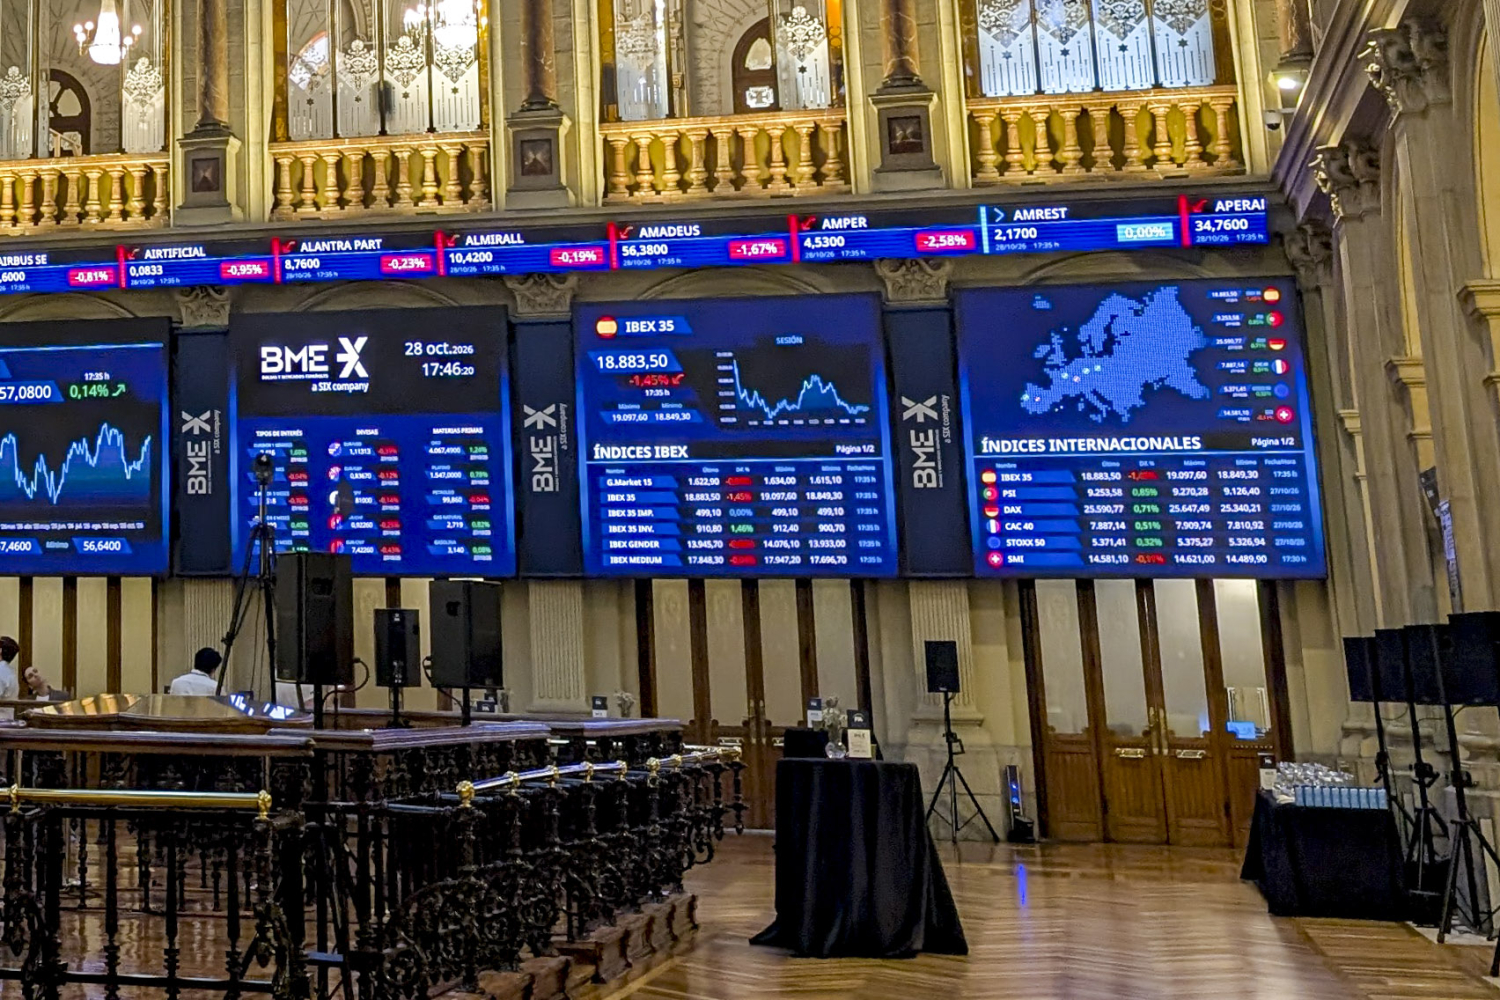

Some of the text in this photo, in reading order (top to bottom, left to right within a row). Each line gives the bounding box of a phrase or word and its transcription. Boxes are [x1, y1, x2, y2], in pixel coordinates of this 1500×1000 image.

[1013, 208, 1068, 222] AMREST
[822, 217, 868, 230] AMPER
[1195, 219, 1248, 231] 34,7600
[639, 225, 700, 239] AMADEUS
[995, 228, 1037, 240] 2,1700
[465, 233, 524, 246] ALMIRALL
[803, 234, 967, 248] 4,5300 -2,58%
[300, 239, 382, 253] ALANTRA PART
[622, 243, 777, 257] 56,3800 -1,67%
[144, 246, 206, 260] AIRTIFICIAL
[449, 251, 597, 264] 10,4200 -0,19%
[35, 254, 48, 265] SE
[284, 258, 425, 270] 8,7600 -0,23%
[129, 263, 263, 277] 0,0833 -0,95%
[75, 271, 109, 283] -0,81%
[625, 319, 675, 333] IBEX 35
[404, 341, 423, 356] 28
[597, 353, 668, 370] 18.883,50
[84, 371, 110, 381] 17:35 h
[629, 374, 669, 387] -1,45%
[69, 384, 109, 400] 0,14%
[318, 382, 332, 392] SIX
[332, 382, 370, 394] company
[612, 412, 691, 423] 19.097,60 18.849,30
[981, 436, 1202, 454] ÍNDICES INTERNACIONALES
[1251, 436, 1296, 447] Página 1/2
[593, 443, 689, 459] ÍNDICES IBEX
[836, 444, 875, 455] Página 1/2
[1000, 473, 1033, 482] IBEX 35
[1166, 471, 1208, 481] 19.097,60
[1217, 470, 1259, 480] 18.849,30
[643, 478, 653, 487] 15
[763, 476, 797, 486] 1.634,00
[760, 491, 798, 501] 19.097,60
[1002, 489, 1017, 498] PSI
[1171, 487, 1209, 497] 9.270,28
[1223, 486, 1261, 497] 9.126,40
[607, 493, 636, 502] IBEX 35
[608, 509, 626, 518] IBEX
[771, 508, 799, 518] 499,10
[1003, 505, 1022, 515] DAX
[1168, 503, 1211, 514] 25.647,49
[1220, 503, 1262, 514] 25.340,21
[608, 525, 627, 534] IBEX
[772, 523, 800, 533] 912,40
[1004, 522, 1034, 531] CAC 40
[1175, 520, 1212, 531] 7.909,74
[1226, 520, 1265, 531] 7.810,92
[82, 540, 121, 552] 56,6400
[609, 540, 628, 549] IBEX
[763, 539, 801, 549] 14.076,10
[1006, 538, 1046, 547] STOXX 50
[1176, 537, 1214, 547] 5.375,27
[1228, 537, 1267, 547] 5.326,94
[609, 555, 663, 565] IBEX MEDIUM
[764, 555, 802, 565] 17.947,20
[1007, 554, 1024, 564] SMI
[1173, 554, 1216, 564] 14.621,00
[1225, 554, 1268, 564] 14.489,90
